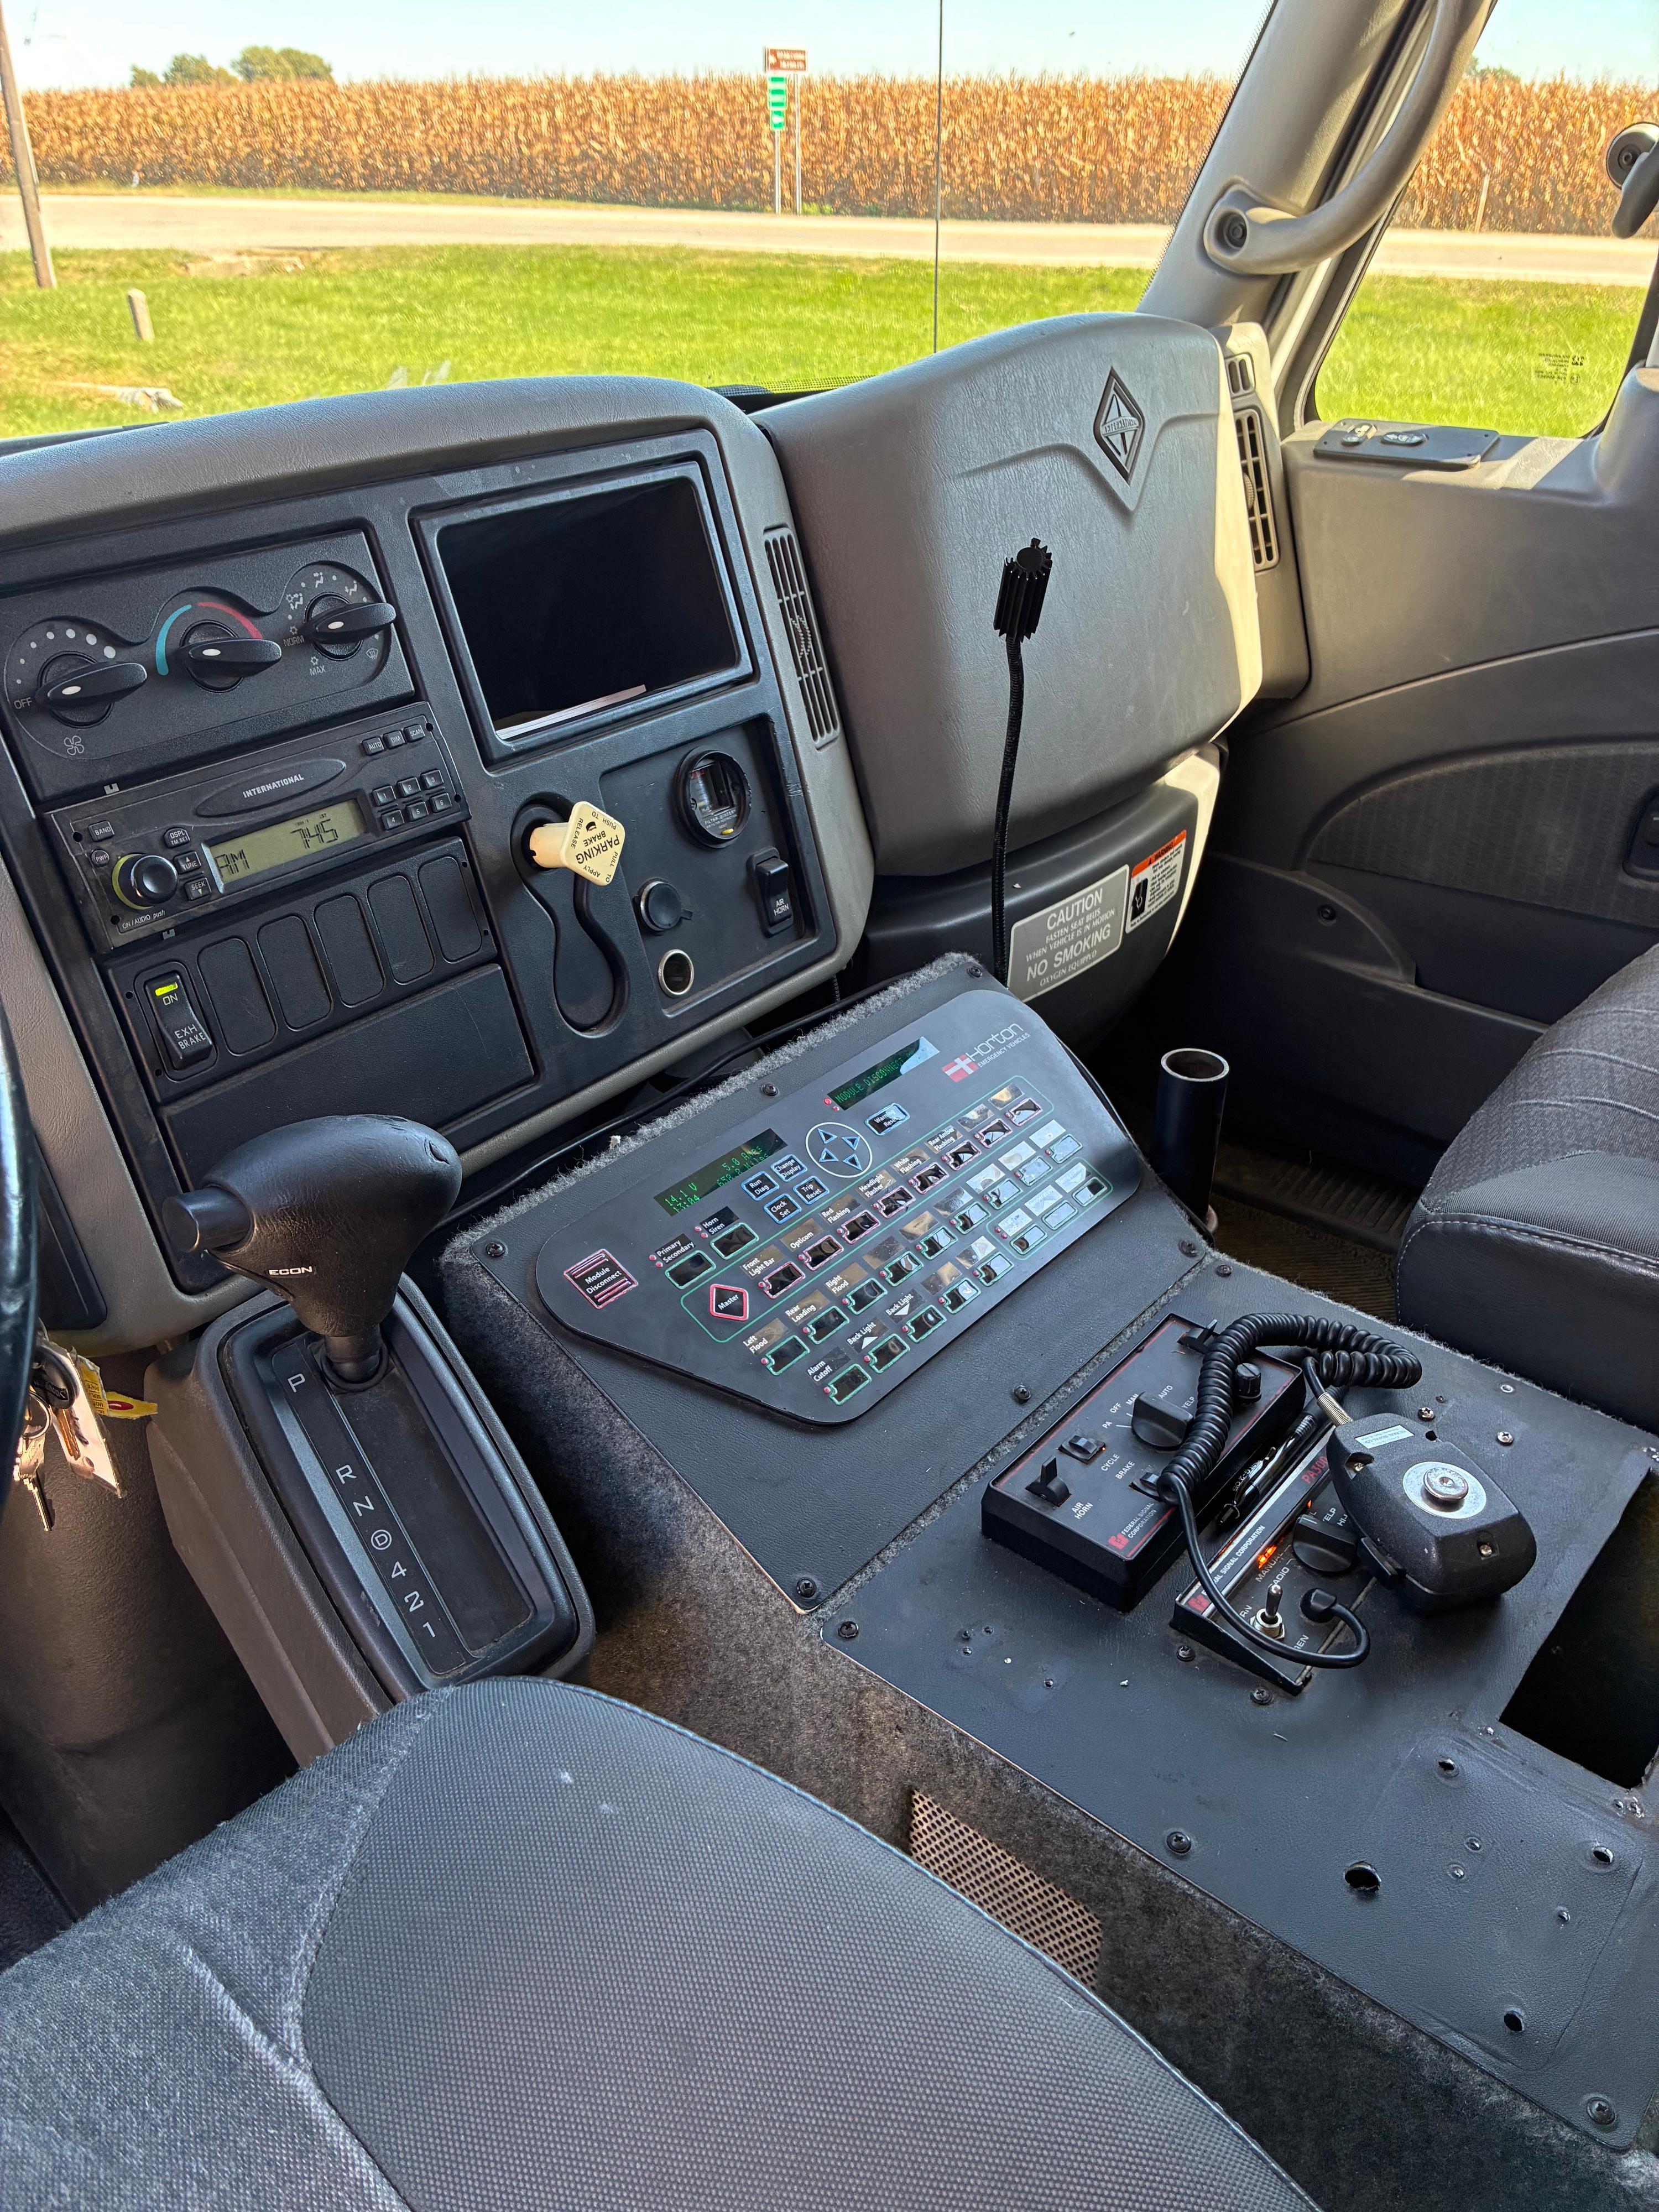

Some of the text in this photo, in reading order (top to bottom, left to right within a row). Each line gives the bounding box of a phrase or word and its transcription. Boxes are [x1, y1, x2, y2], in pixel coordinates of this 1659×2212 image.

[283, 634, 305, 648] NORM
[310, 665, 326, 675] MAX
[14, 696, 33, 709] OFF
[410, 728, 422, 737] SCAN
[369, 742, 382, 750] AUTO
[242, 774, 304, 799] INTERNATIONAL
[592, 811, 599, 820] TO
[95, 826, 112, 836] BAND
[602, 818, 617, 830] PUSH
[571, 818, 583, 849] RELEASE
[583, 831, 606, 847] BRAKE
[576, 834, 620, 864] PARKING
[96, 854, 108, 862] PWR
[182, 860, 198, 870] TUNE
[216, 849, 250, 879] AM
[610, 852, 618, 867] PULL
[583, 865, 601, 878] APPLY
[606, 874, 612, 883] TO
[191, 881, 205, 890] SEEK
[774, 904, 789, 916] HORN
[776, 898, 785, 907] AIR
[1047, 888, 1103, 931] CAUTION
[134, 914, 151, 925] AUDIO
[153, 910, 165, 920] push
[1046, 907, 1102, 944] FASTEN SEAT BELTS
[1026, 946, 1047, 962] WHEN
[1050, 933, 1075, 951] VEHICLE
[1076, 929, 1082, 938] IS
[1083, 923, 1091, 933] IN
[1092, 907, 1115, 929] MOTION
[1026, 923, 1111, 982] NO SMOKING
[1040, 967, 1067, 987] OXYGEN
[163, 993, 178, 1005] ON
[175, 1024, 197, 1039] EXH
[178, 1032, 206, 1050] BRAKE
[966, 1023, 1024, 1061] Horton
[977, 1032, 1030, 1067] EMERGENCY VEHICLES
[834, 1057, 904, 1103] MODULE DISCONNECT
[874, 1109, 895, 1124] Warning
[883, 1117, 899, 1128] Reset
[928, 1126, 955, 1146] Rear Amber
[933, 1136, 956, 1151] Flashing
[775, 1159, 795, 1172] Change
[894, 1156, 910, 1168] White
[900, 1158, 922, 1175] Flashing
[781, 1165, 801, 1178] Display
[665, 1189, 688, 1206] 14.1
[688, 1182, 697, 1191] V
[722, 1158, 740, 1171] 5.0
[749, 1179, 762, 1188] Run
[801, 1183, 814, 1193] Trip
[859, 1173, 885, 1192] Headlight
[754, 1185, 770, 1196] Diag
[806, 1188, 822, 1200] Reset
[865, 1183, 884, 1198] Flasher
[771, 1200, 787, 1212] Clock
[780, 1208, 791, 1218] Set
[821, 1208, 834, 1218] Red
[702, 1216, 719, 1229] Horn
[828, 1207, 851, 1224] Flashing
[709, 1222, 725, 1235] Siren
[790, 1231, 815, 1250] Opticom
[656, 1240, 682, 1259] Primary
[662, 1241, 695, 1264] Secondary
[269, 1266, 312, 1275] ECON
[743, 1256, 760, 1270] Front
[749, 1257, 775, 1277] Light Bar
[585, 1265, 611, 1285] Module
[586, 1270, 622, 1295] Disconnect
[825, 1274, 843, 1290] Right
[831, 1280, 849, 1295] Flood
[718, 1293, 740, 1310] Master
[885, 1293, 914, 1317] Back Light
[785, 1304, 800, 1317] Rear
[791, 1304, 816, 1325] Loading
[743, 1335, 757, 1348] Left
[847, 1322, 877, 1346] Back Light
[749, 1337, 768, 1354] Flood
[807, 1359, 826, 1376] Alarm
[813, 1365, 832, 1383] Cutoff
[287, 1373, 306, 1392] P
[1158, 1385, 1173, 1399] AUTO
[1126, 1394, 1139, 1406] MAN
[1182, 1396, 1195, 1410] YELP
[1110, 1403, 1121, 1413] OFF
[1102, 1421, 1112, 1429] PA
[1101, 1453, 1120, 1472] CYCLE
[1115, 1460, 1135, 1479] BRAKE
[1301, 1456, 1328, 1484] PA300
[336, 1464, 357, 1484] R
[353, 1495, 374, 1517] N
[1071, 1502, 1084, 1513] AIR
[1074, 1502, 1093, 1520] HORN
[1121, 1503, 1154, 1535] FEDERAL SIGNAL
[1322, 1507, 1336, 1522] ELP
[1128, 1509, 1157, 1538] CORPORATION
[1220, 1525, 1265, 1578] SIGNAL CORPORATION
[391, 1561, 406, 1578] 4
[1255, 1552, 1283, 1582] MANUAL
[1269, 1566, 1290, 1587] ADIO
[405, 1592, 424, 1612] 2
[1239, 1605, 1253, 1618] RN
[423, 1623, 436, 1637] 1
